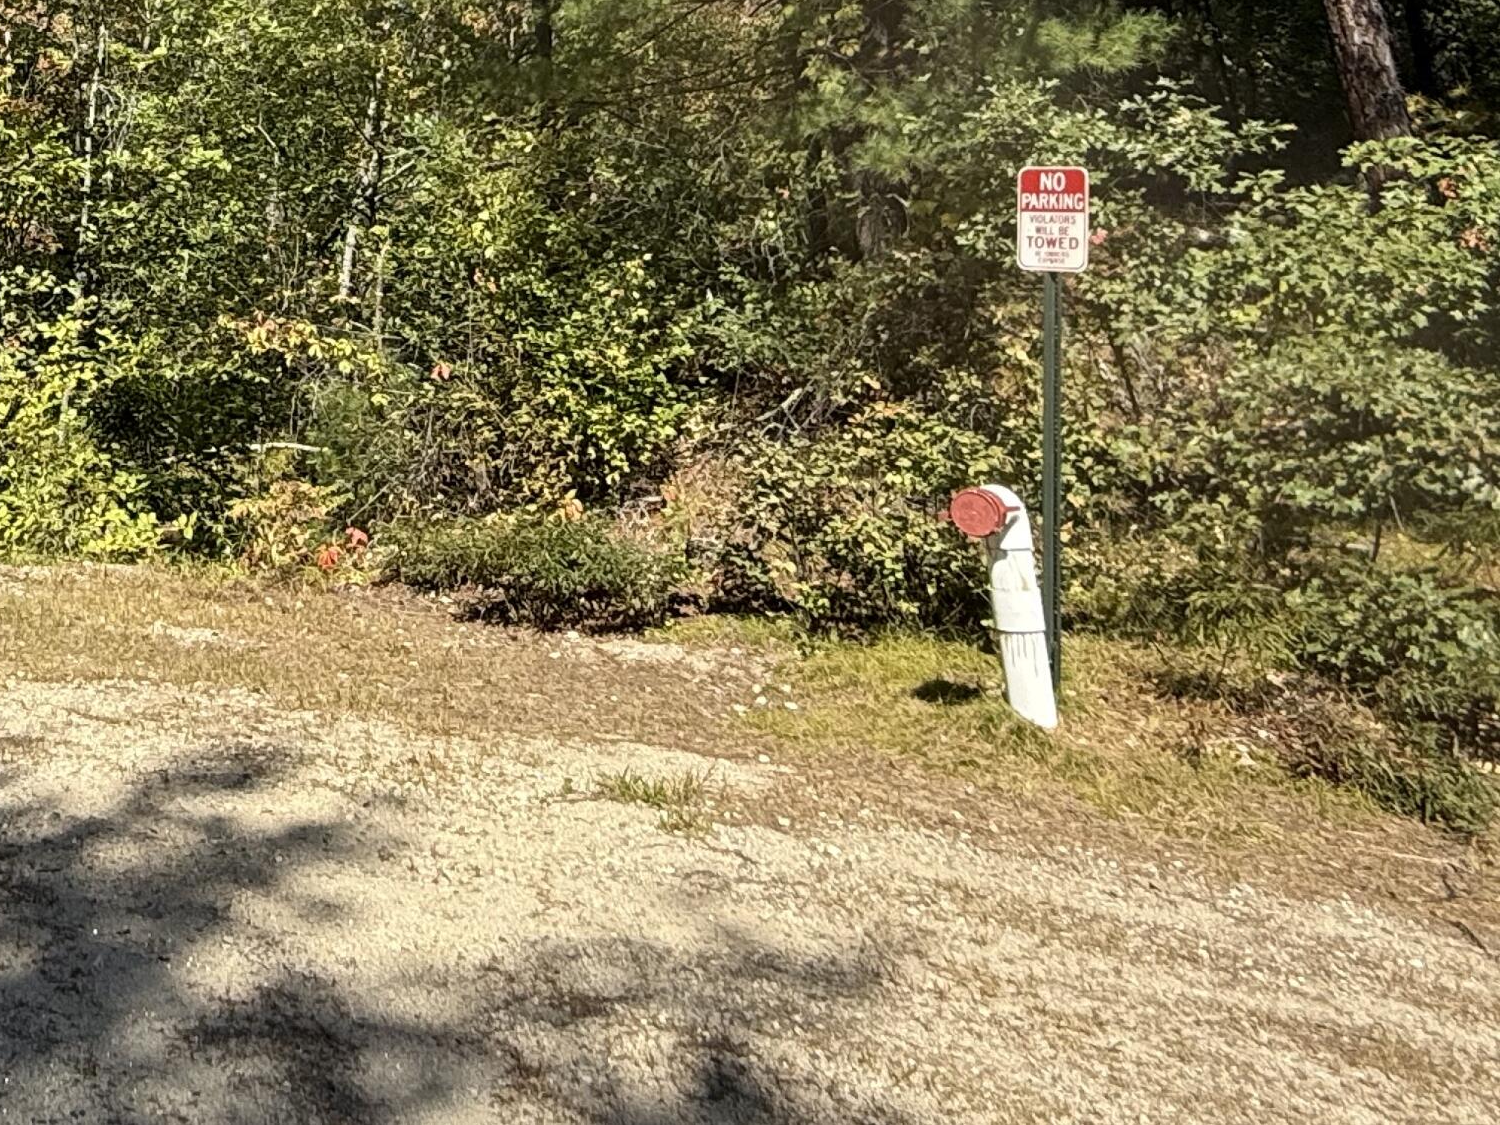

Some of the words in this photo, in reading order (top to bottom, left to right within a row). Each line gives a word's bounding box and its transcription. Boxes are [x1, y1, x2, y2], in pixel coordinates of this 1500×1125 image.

[1040, 172, 1066, 191] NO
[1021, 192, 1084, 210] PARKING
[1030, 215, 1076, 224] VIOLATORS
[1035, 226, 1054, 235] WILL
[1058, 226, 1070, 236] BE
[1026, 236, 1079, 250] TOWED
